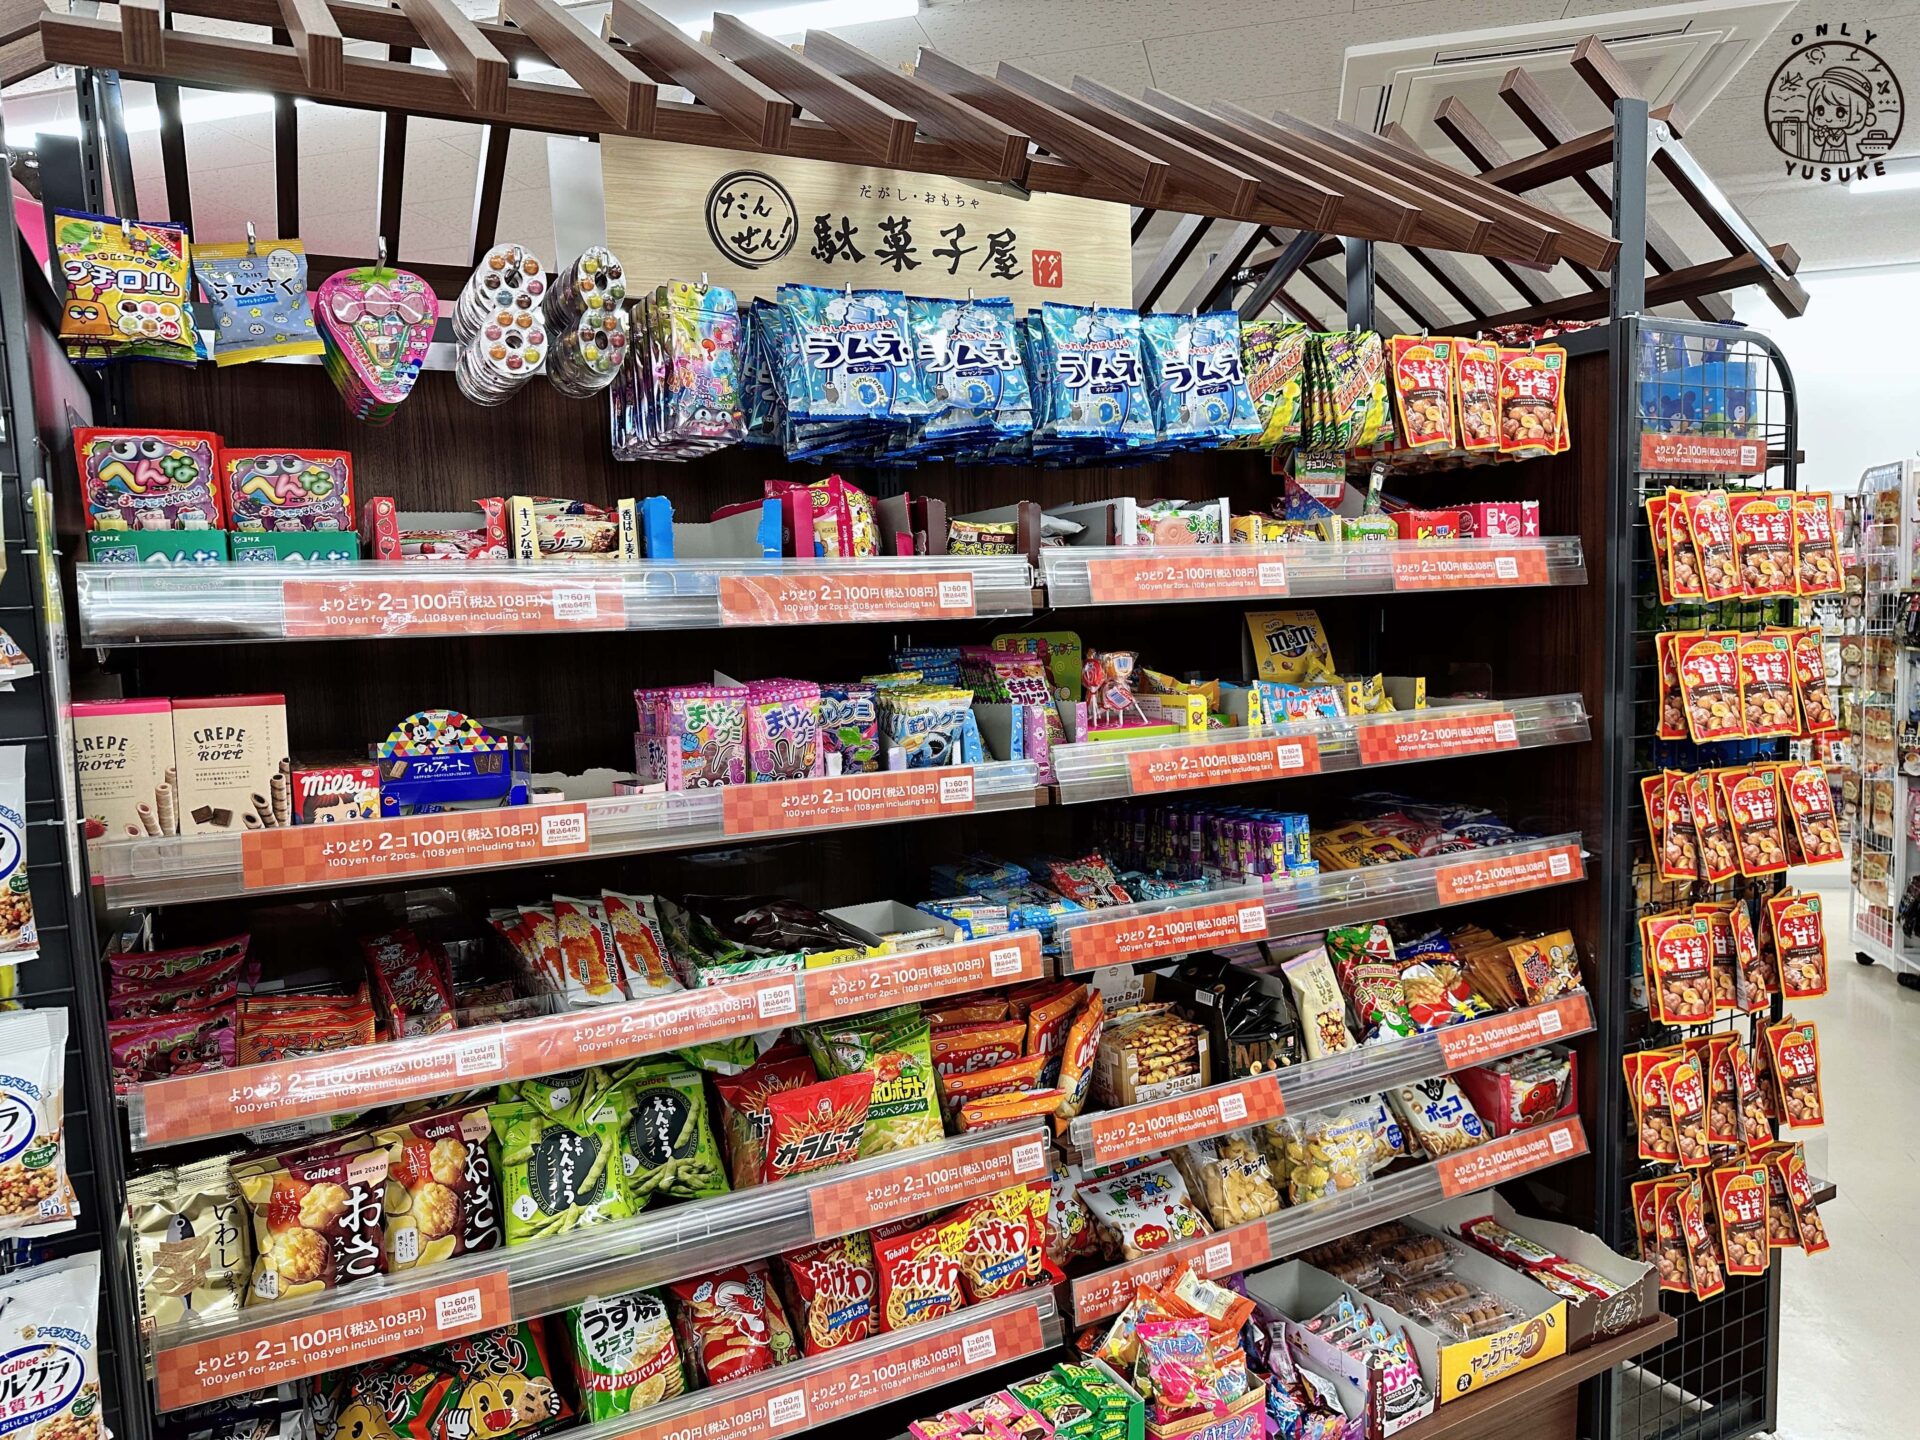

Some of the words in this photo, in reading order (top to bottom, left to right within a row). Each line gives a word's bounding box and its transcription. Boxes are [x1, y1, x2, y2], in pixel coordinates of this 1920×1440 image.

[719, 192, 772, 219] だん
[859, 184, 980, 209] だがし・おもちゃ
[811, 213, 1024, 280] 駄菓子屋
[63, 260, 182, 297] プチロル
[808, 332, 907, 368] ラムネ
[1057, 355, 1142, 385] ラムネ
[1164, 356, 1246, 391] ラムネ
[99, 456, 199, 494] へんな
[1306, 461, 1337, 470] チョコレート
[242, 471, 334, 504] へんな
[1437, 527, 1449, 535] NEW
[1265, 624, 1317, 653] m&m's
[1007, 678, 1045, 693] もぎもぎ
[1011, 691, 1050, 705] フルーツ
[685, 703, 743, 731] まけん
[765, 707, 816, 737] まけん
[908, 710, 967, 735] 釣りグミ
[75, 736, 128, 753] CREPE
[194, 727, 246, 743] CREPE
[198, 742, 242, 750] クレープロール
[715, 728, 742, 745] グミ
[794, 728, 815, 746] グミ
[79, 759, 127, 771] ROLL
[198, 750, 244, 761] ROLL
[413, 759, 470, 774] アルフォート
[301, 772, 368, 803] Milky
[817, 806, 828, 814] for
[830, 804, 851, 813] 2pcs.
[886, 798, 919, 808] including
[921, 797, 935, 805] tax)
[371, 853, 387, 862] for
[390, 850, 418, 862] 2pcs.
[467, 841, 513, 853] including
[515, 839, 535, 849] tax)
[865, 991, 877, 999] for
[879, 987, 899, 998] 2pcs.
[934, 975, 967, 987] including
[969, 972, 982, 981] tax)
[1124, 989, 1145, 1004] Ball
[616, 1036, 628, 1045] for
[631, 1031, 655, 1043] 2pcs.
[696, 1015, 735, 1029] including
[737, 1012, 753, 1022] tax)
[635, 1075, 667, 1087] Calbee
[1424, 1095, 1464, 1121] ポテコ
[425, 1124, 456, 1139] Calbee
[653, 1096, 673, 1158] えんどう
[303, 1166, 341, 1181] Calbee
[559, 1134, 574, 1205] えんどう
[1221, 1156, 1244, 1178] チーズ
[1109, 1172, 1159, 1189] ベビースター
[1109, 1174, 1174, 1206] ドデカイ
[464, 1142, 499, 1250] おさつ
[1137, 1194, 1170, 1210] ラーメン
[41, 1203, 67, 1217] 50g
[463, 1190, 473, 1237] スナック
[878, 1224, 901, 1237] Tohato
[333, 1236, 345, 1284] スナック
[793, 1247, 818, 1263] Tohato
[884, 1244, 910, 1260] Tohato
[810, 1258, 876, 1299] なげわ
[891, 1255, 961, 1289] なげわ
[584, 1296, 661, 1342] うす焼
[248, 1363, 265, 1376] for
[268, 1355, 299, 1372] 2pcs.
[351, 1330, 400, 1351] including
[403, 1324, 423, 1338] tax)
[595, 1327, 635, 1357] サラダ
[1490, 1331, 1520, 1347] ミヤタの
[0, 1356, 39, 1376] Calbee
[1470, 1335, 1534, 1374] ヤングドーナツ
[845, 1392, 856, 1401] for
[858, 1385, 878, 1398] 2pcs.
[912, 1364, 945, 1380] including
[946, 1358, 960, 1370] tax)
[1459, 1375, 1470, 1383] 20
